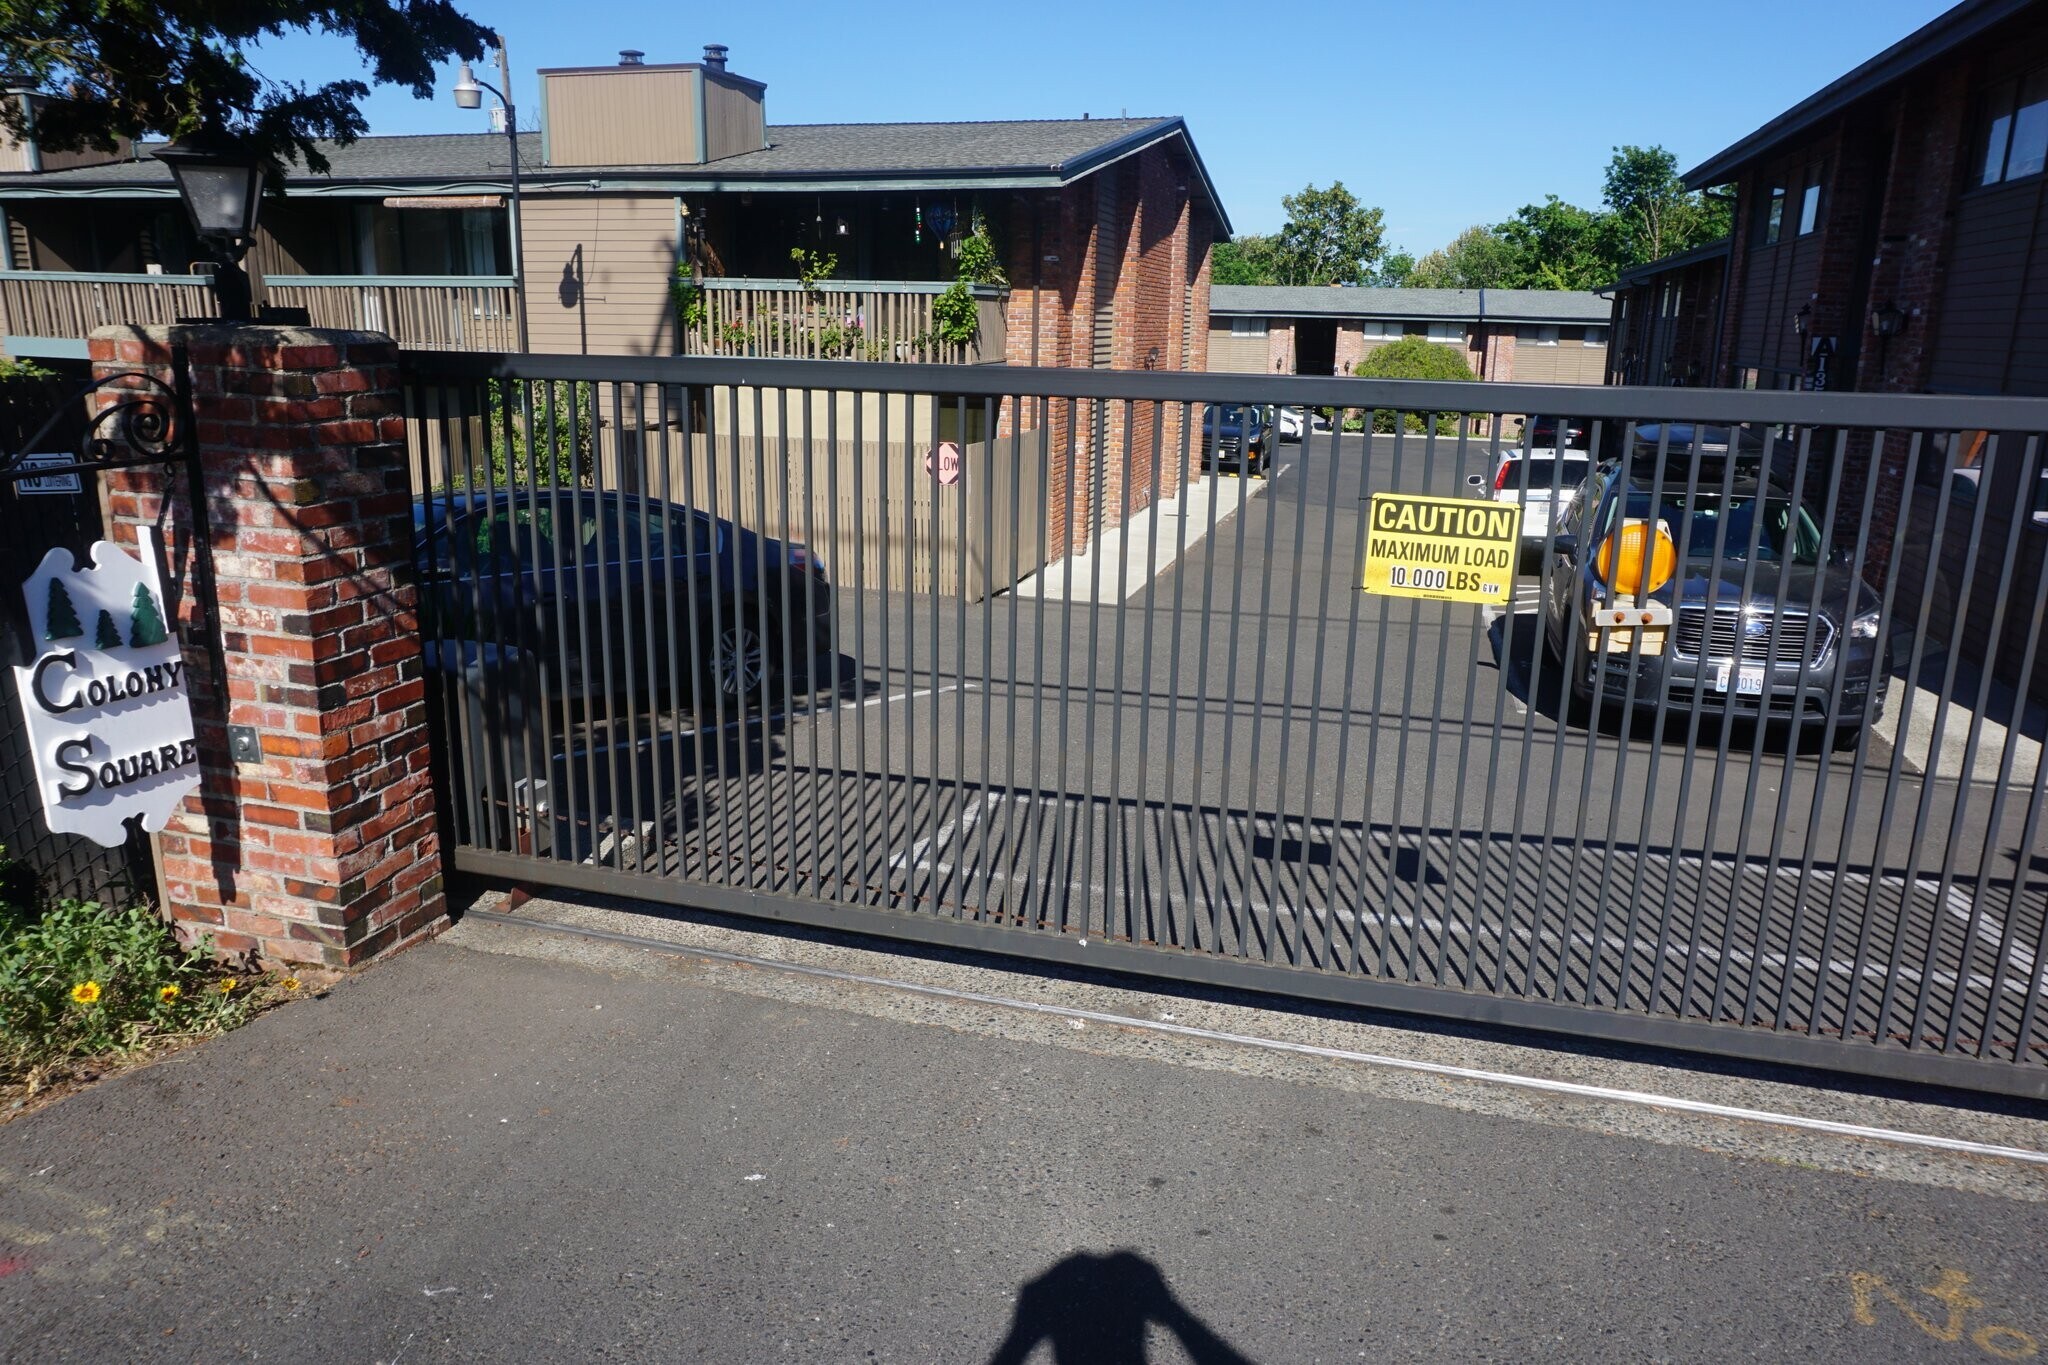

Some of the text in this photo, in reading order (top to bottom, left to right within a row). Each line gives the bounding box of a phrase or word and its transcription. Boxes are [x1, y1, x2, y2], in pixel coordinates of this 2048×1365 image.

[1378, 502, 1511, 539] CAUTION
[1371, 538, 1510, 569] MAXIMUM LOAD
[1446, 571, 1482, 592] LBS
[32, 651, 183, 714] COLONY
[1720, 676, 1762, 691] C019
[55, 735, 197, 801] SQUARE
